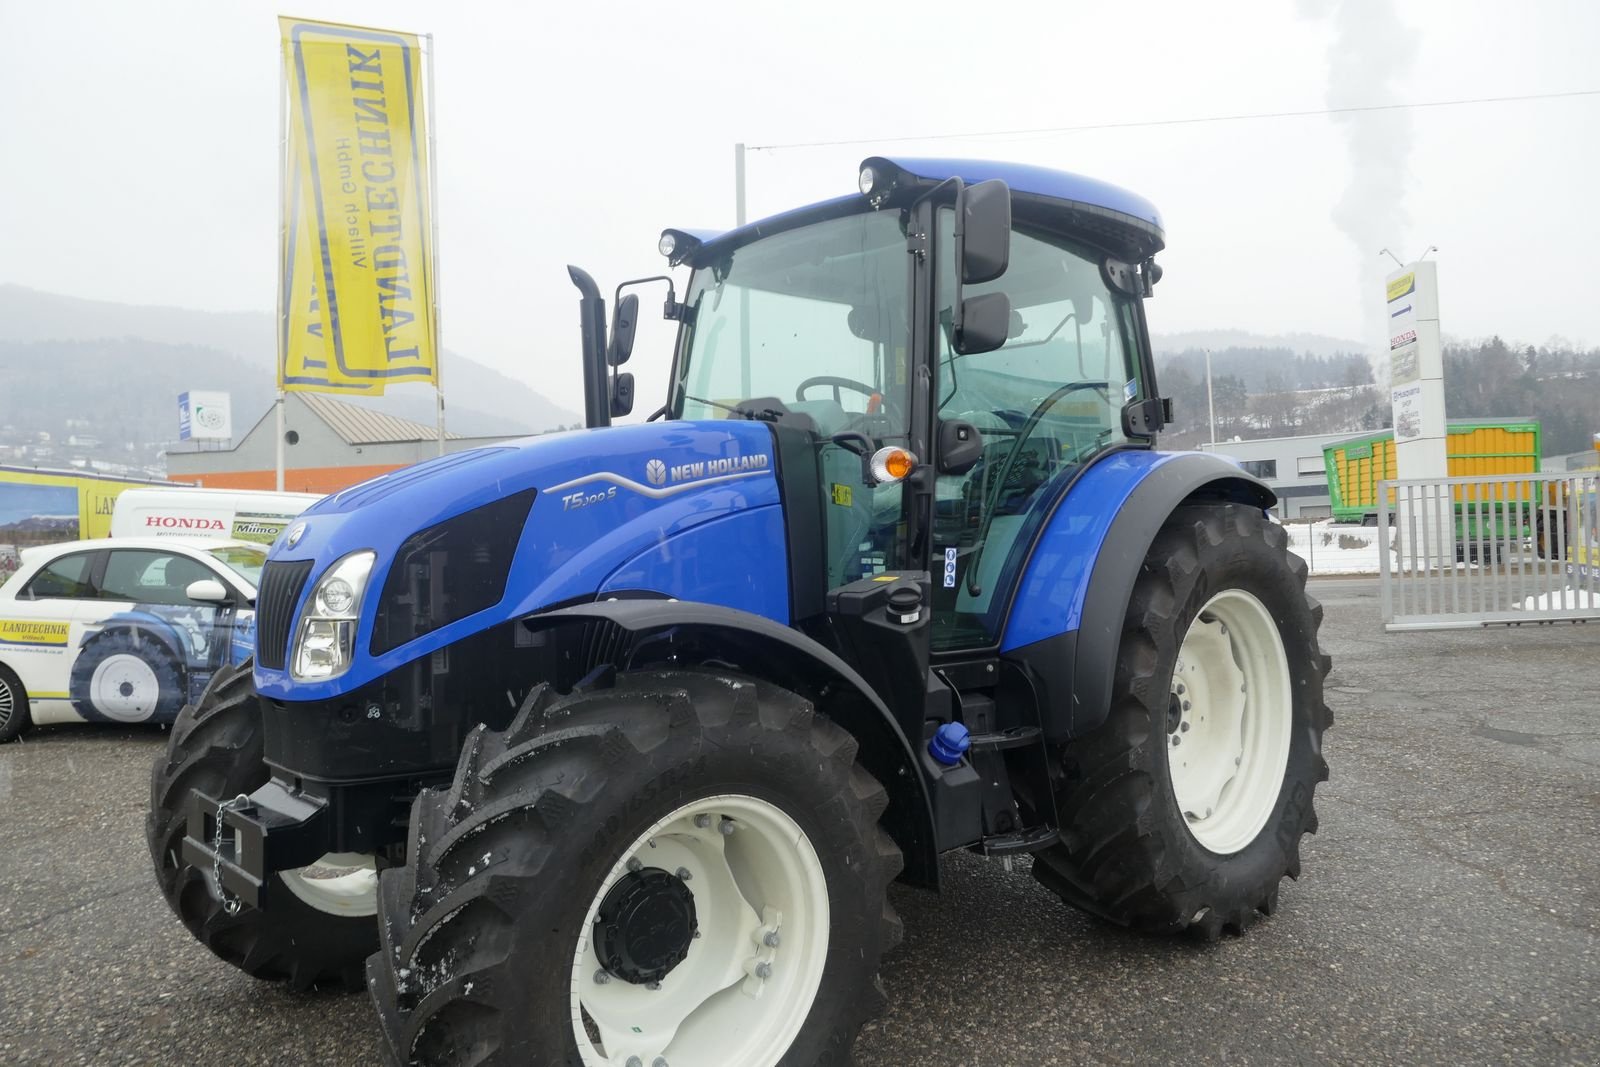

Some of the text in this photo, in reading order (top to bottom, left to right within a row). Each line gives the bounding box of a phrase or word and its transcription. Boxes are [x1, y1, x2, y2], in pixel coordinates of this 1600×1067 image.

[1390, 329, 1417, 346] HONDA
[670, 454, 768, 482] NEW HOLLAND
[145, 516, 226, 530] HONDA
[2, 622, 68, 635] LANDTECHNIK
